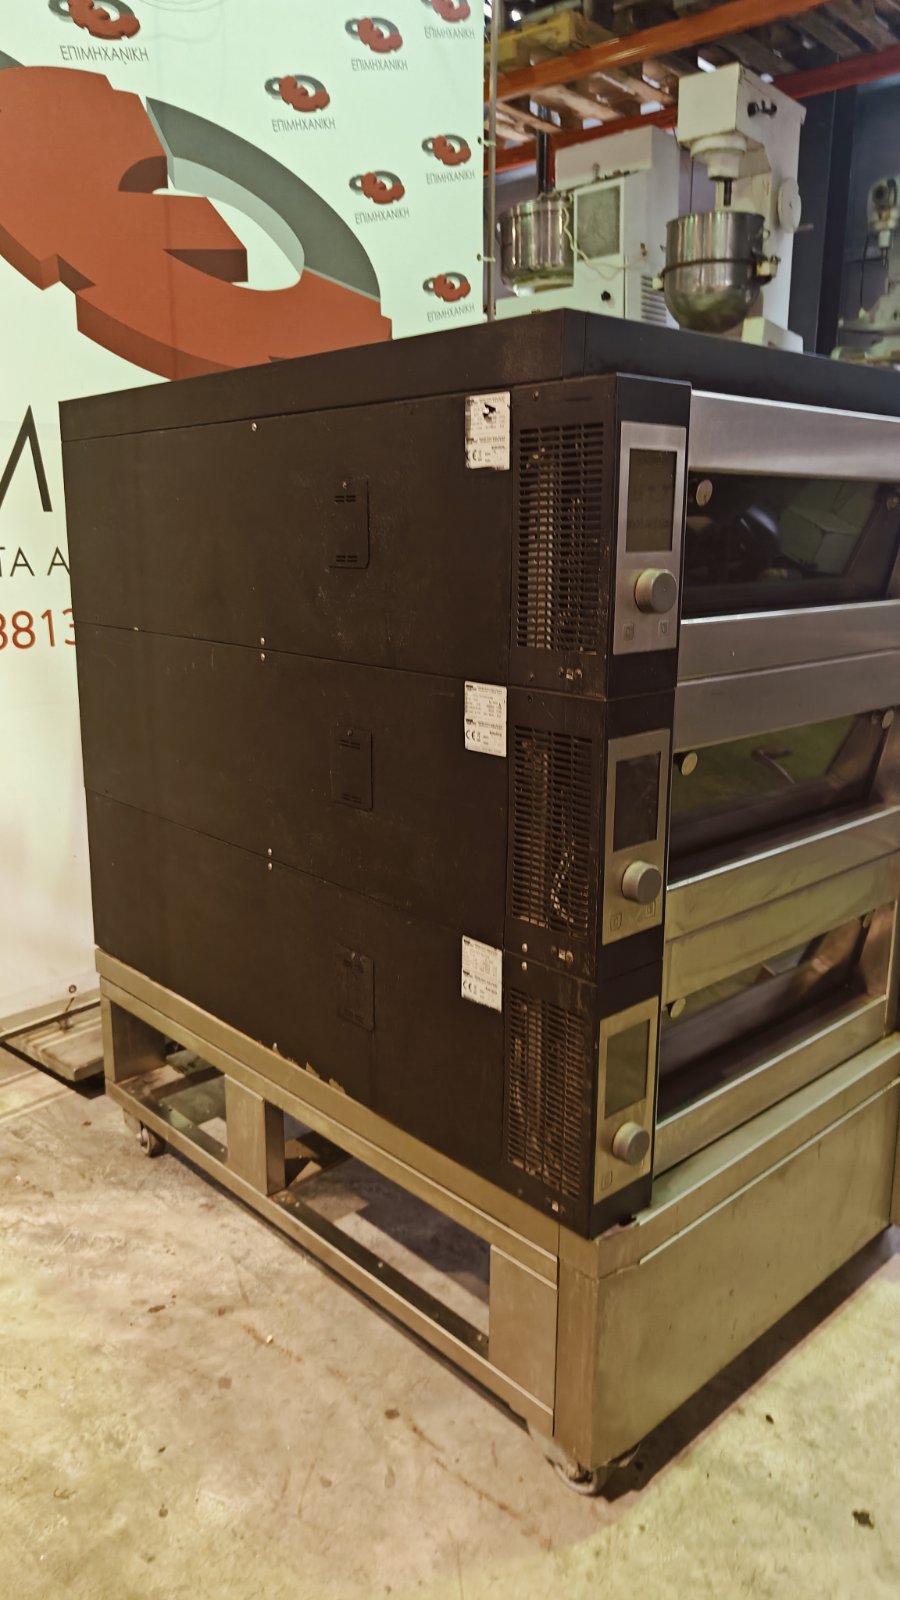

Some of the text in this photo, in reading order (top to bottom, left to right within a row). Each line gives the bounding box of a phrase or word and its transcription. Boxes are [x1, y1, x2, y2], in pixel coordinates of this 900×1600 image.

[59, 45, 149, 64] ΕΠΙΜΗΧΑΝΙΚΗ
[351, 58, 408, 72] ΕΠΙΜΗΧΑΝΙΚΗ
[271, 117, 336, 133] ΕΠΙΜΗΧΑΝΙΚΗ
[354, 207, 410, 225] ΕΠΙΜΗΧΑΝΙΚΗ
